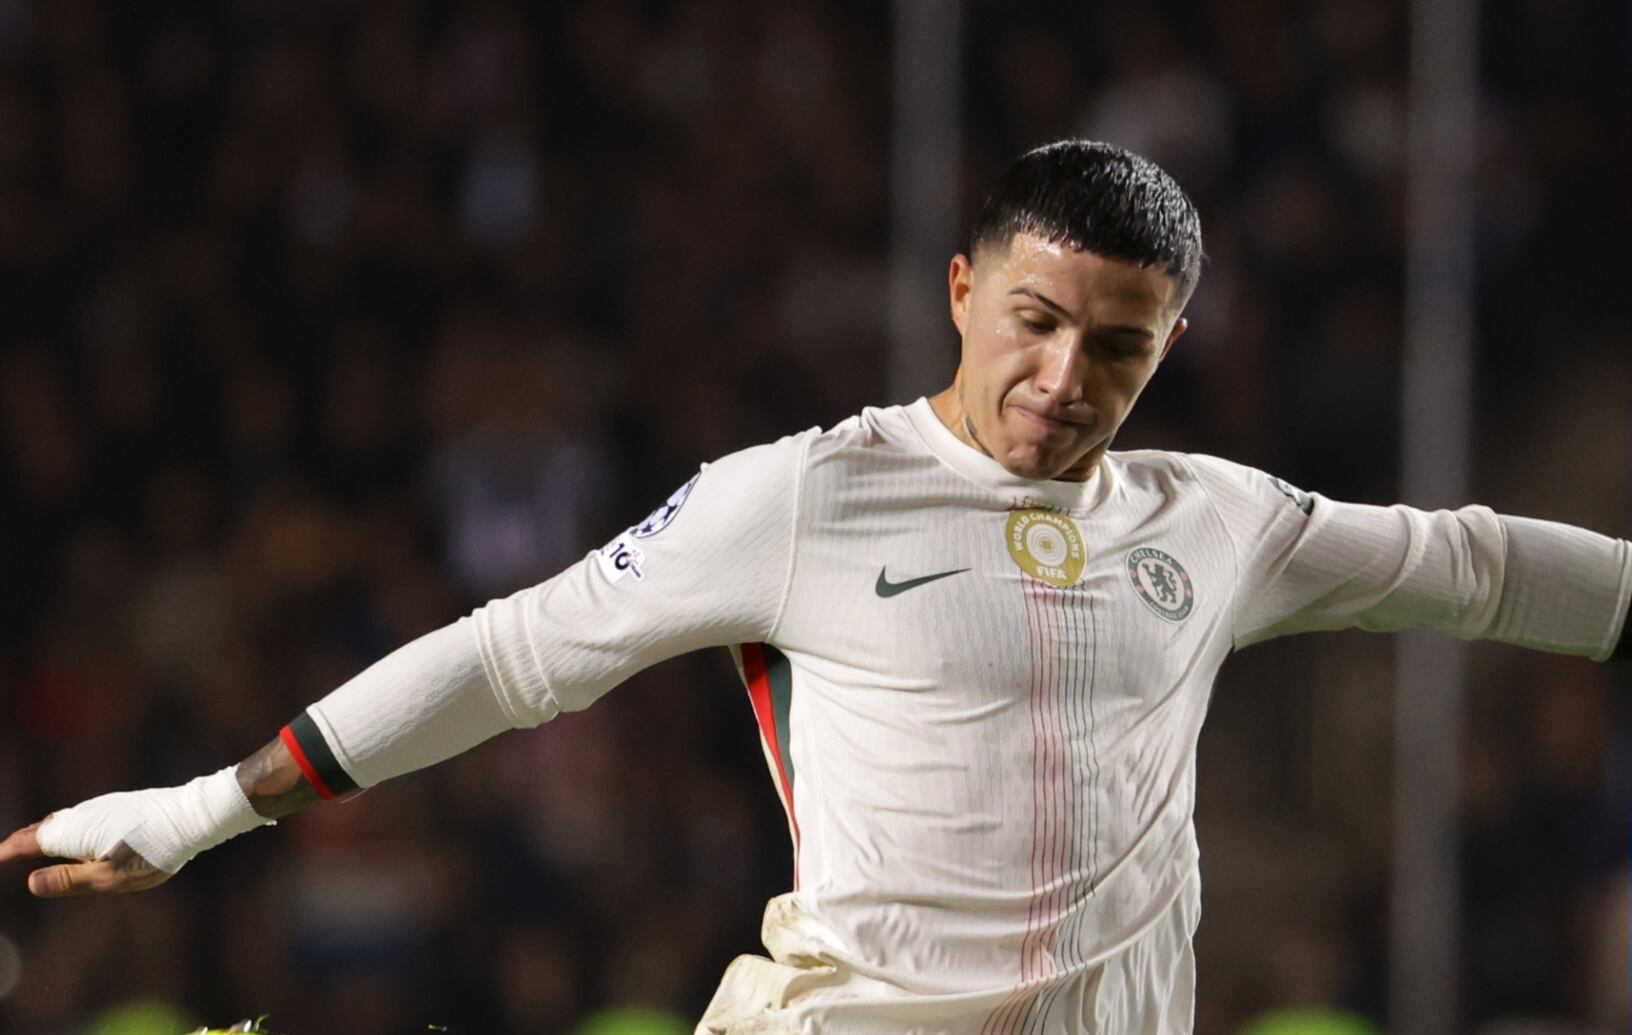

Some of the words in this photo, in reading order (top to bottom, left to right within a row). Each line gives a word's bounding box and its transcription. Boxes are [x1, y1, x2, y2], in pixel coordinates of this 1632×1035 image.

[1013, 515, 1030, 551] WORLD
[1029, 513, 1080, 559] CHAMPIONS
[609, 543, 631, 571] 10
[1130, 549, 1173, 565] CHELSEA
[1036, 566, 1068, 580] FIFA
